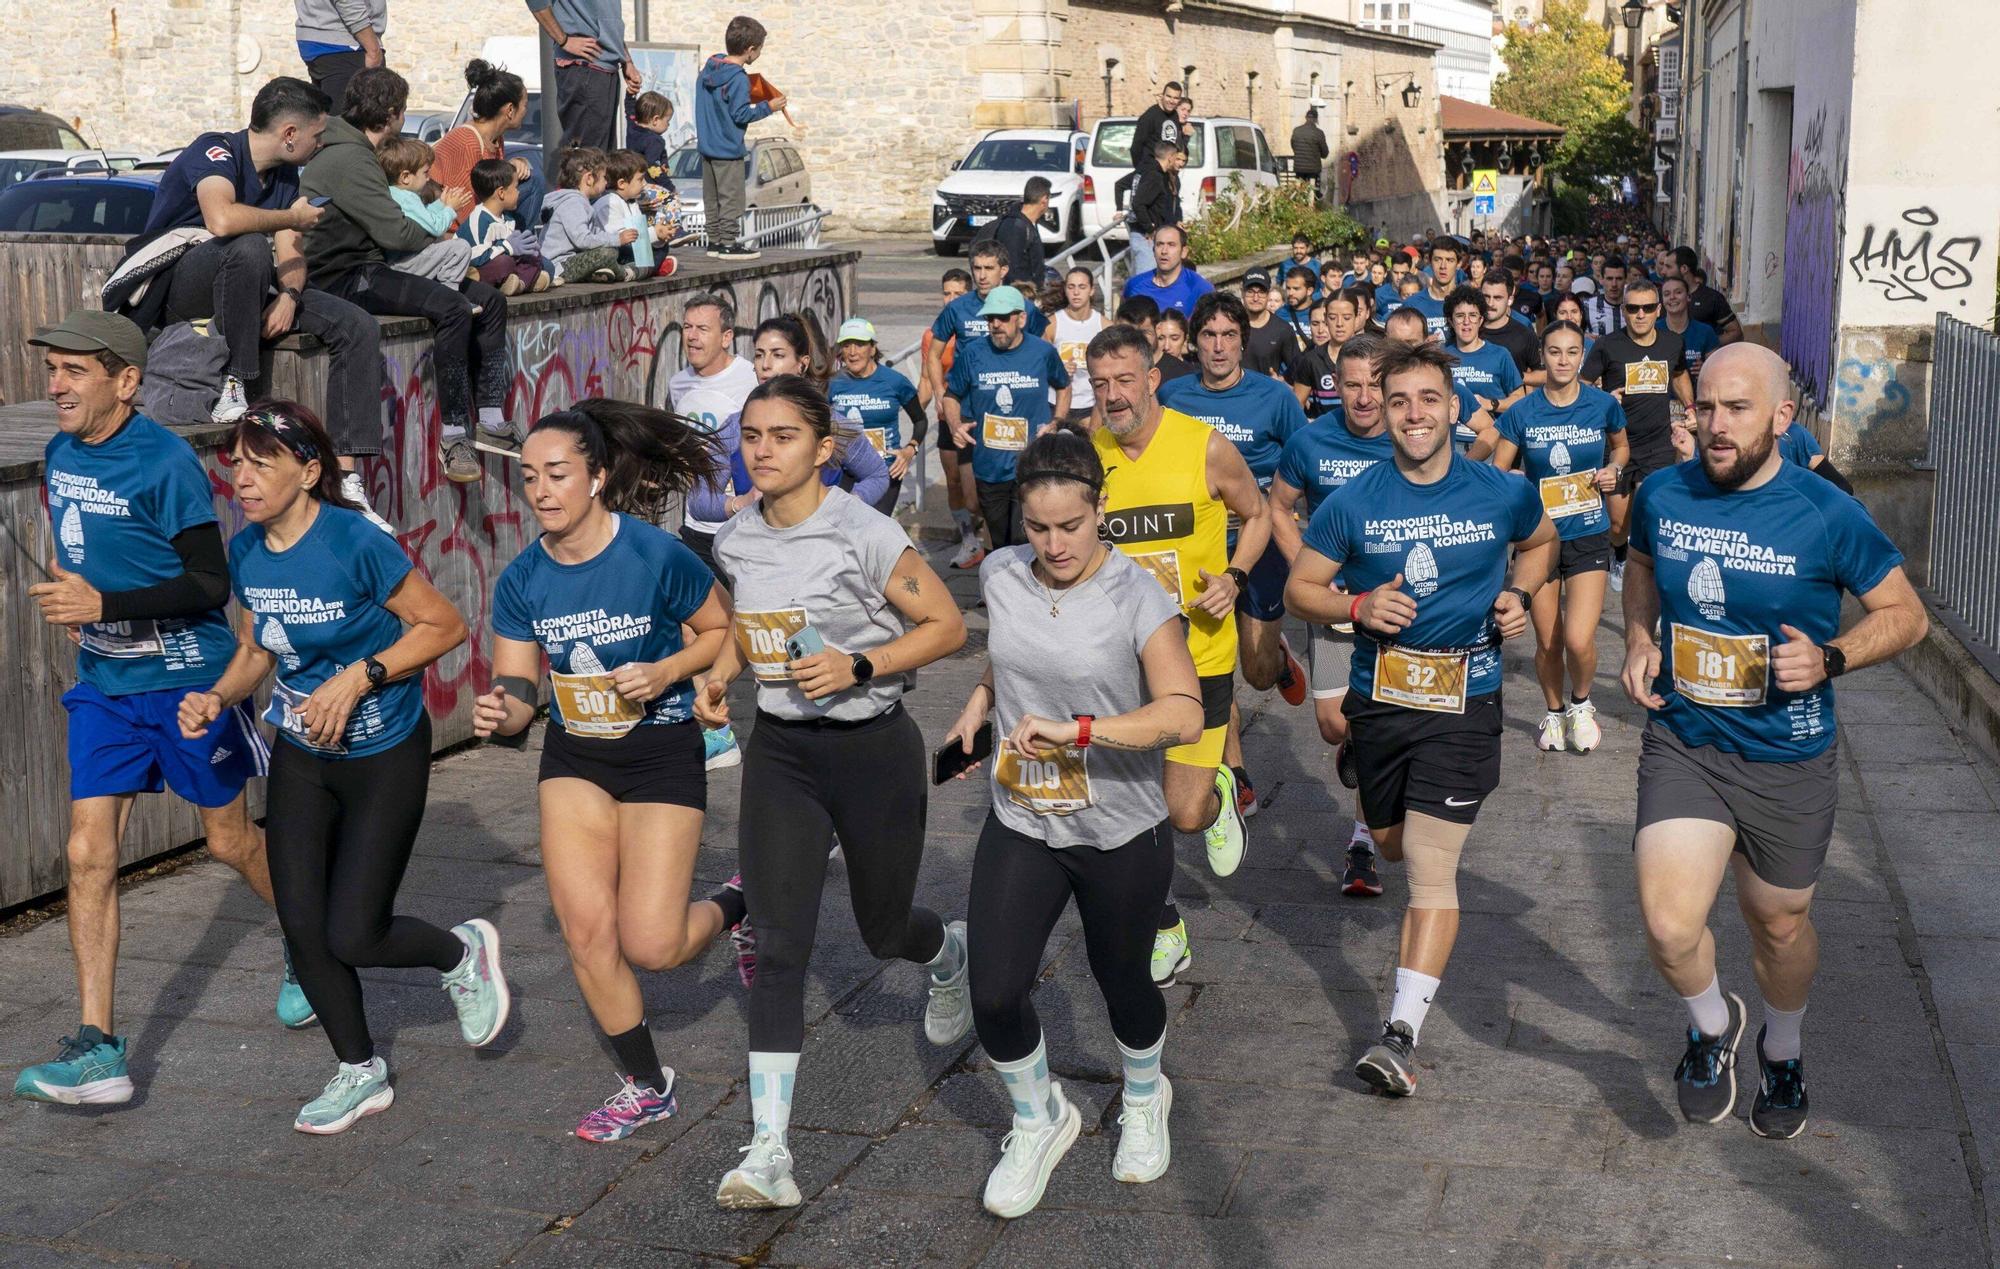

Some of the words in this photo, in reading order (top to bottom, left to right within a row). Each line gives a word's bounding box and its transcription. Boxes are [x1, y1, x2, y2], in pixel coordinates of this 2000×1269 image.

[1638, 368, 1659, 382] 222
[1534, 424, 1579, 434] CONQUISTA
[1536, 427, 1594, 442] ALMENDRA
[1319, 459, 1331, 467] LA
[56, 482, 116, 504] ALMENDRA
[80, 501, 132, 517] KONKISTA
[1365, 520, 1379, 530] LA
[1380, 513, 1450, 529] CONQUISTA
[1383, 519, 1477, 543] ALMENDRA
[1476, 522, 1493, 531] REN
[1659, 518, 1672, 530] LA
[1672, 521, 1748, 544] CONQUISTA
[1433, 530, 1496, 548] KONKISTA
[1659, 528, 1667, 536] DE
[1667, 530, 1675, 538] LA
[1671, 533, 1776, 562] ALMENDRA
[1776, 554, 1796, 564] REN
[1723, 556, 1796, 577] KONKISTA
[252, 597, 325, 613] ALMENDRA
[325, 600, 344, 610] REN
[283, 608, 346, 625] KONKISTA
[541, 608, 608, 630] CONQUISTA
[547, 613, 634, 643] ALMENDRA
[634, 615, 652, 626] REN
[592, 624, 652, 647] KONKISTA
[1406, 663, 1437, 688] 32
[1695, 650, 1736, 680] 181
[1016, 759, 1060, 790] 709
